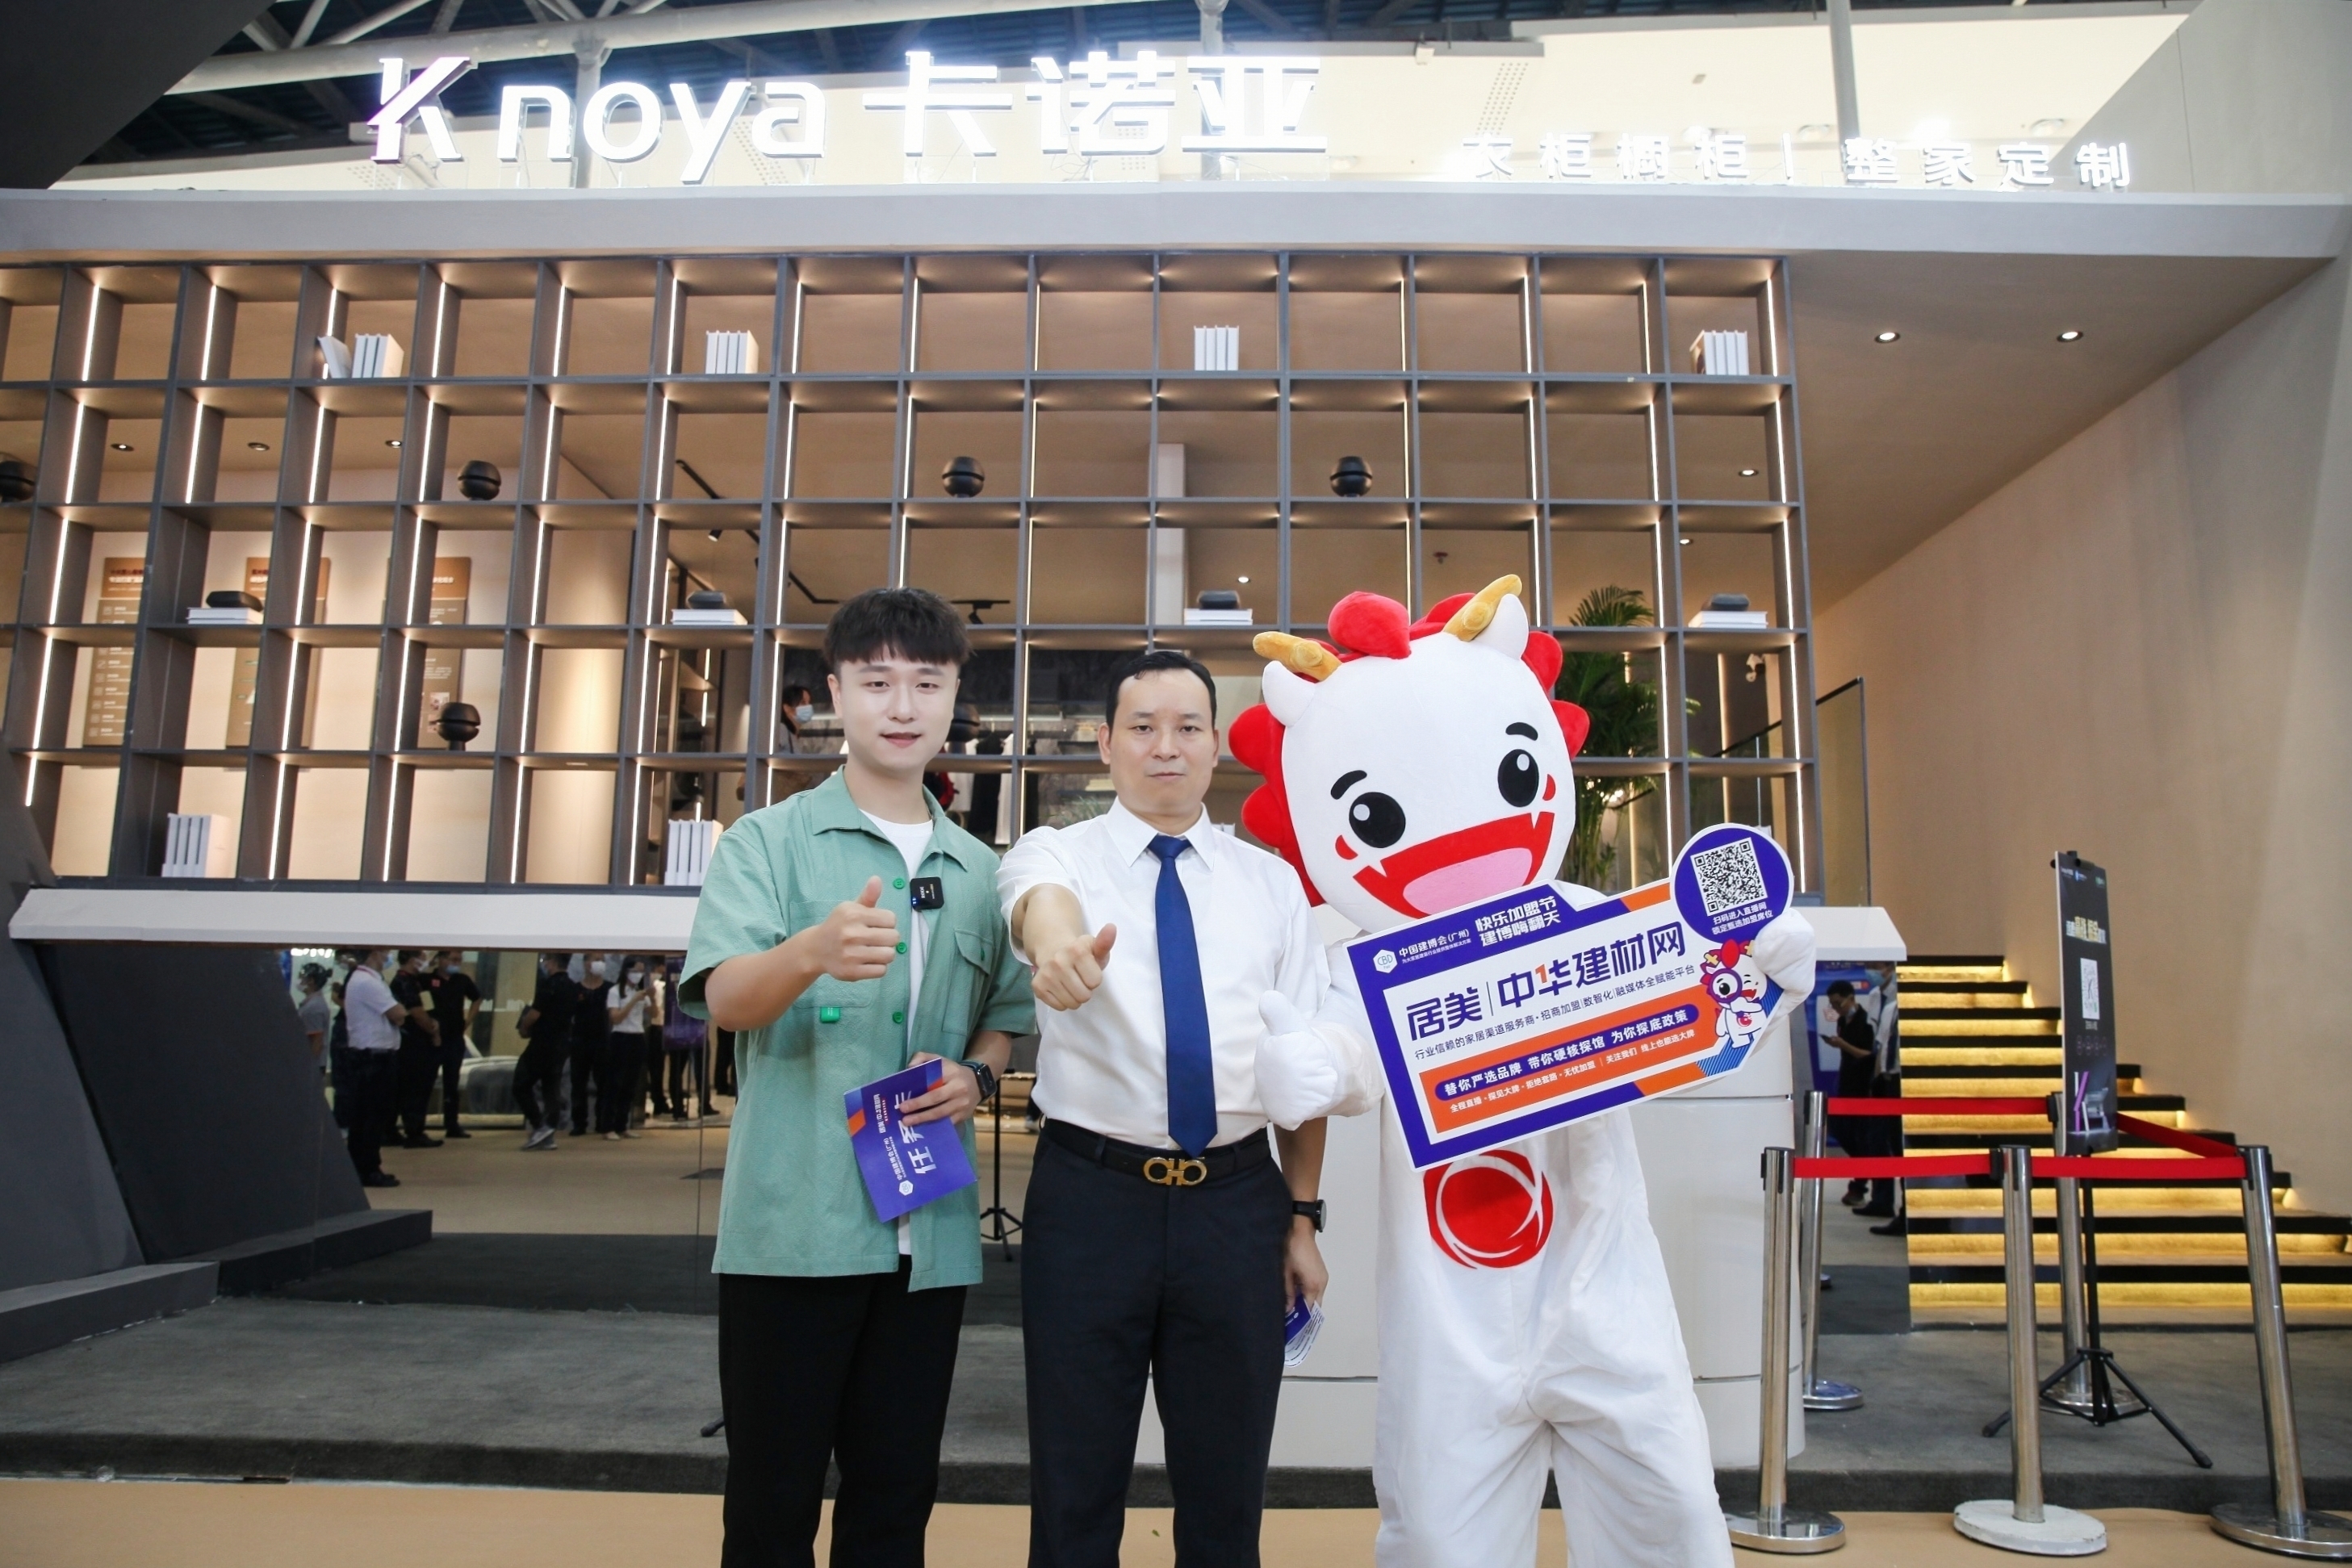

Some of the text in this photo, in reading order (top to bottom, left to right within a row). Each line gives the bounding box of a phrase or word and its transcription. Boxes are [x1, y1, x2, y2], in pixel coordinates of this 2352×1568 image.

[366, 49, 1329, 185] Knoya 卡诺亚
[1845, 137, 2131, 187] 整家定制
[1475, 895, 1557, 933] 快乐加盟节
[1479, 909, 1562, 947] 建博嗨翻天
[1713, 901, 1767, 925] 扫码进入直播间
[1377, 954, 1394, 967] CBD
[1399, 929, 1470, 958] 中国建博会(广州)
[1406, 921, 1687, 1041] 居美 中华建材网
[1444, 1009, 1689, 1097] 替你严选品牌 带你硬核探馆 为你探底政策
[1605, 1047, 1638, 1064] 关注我们
